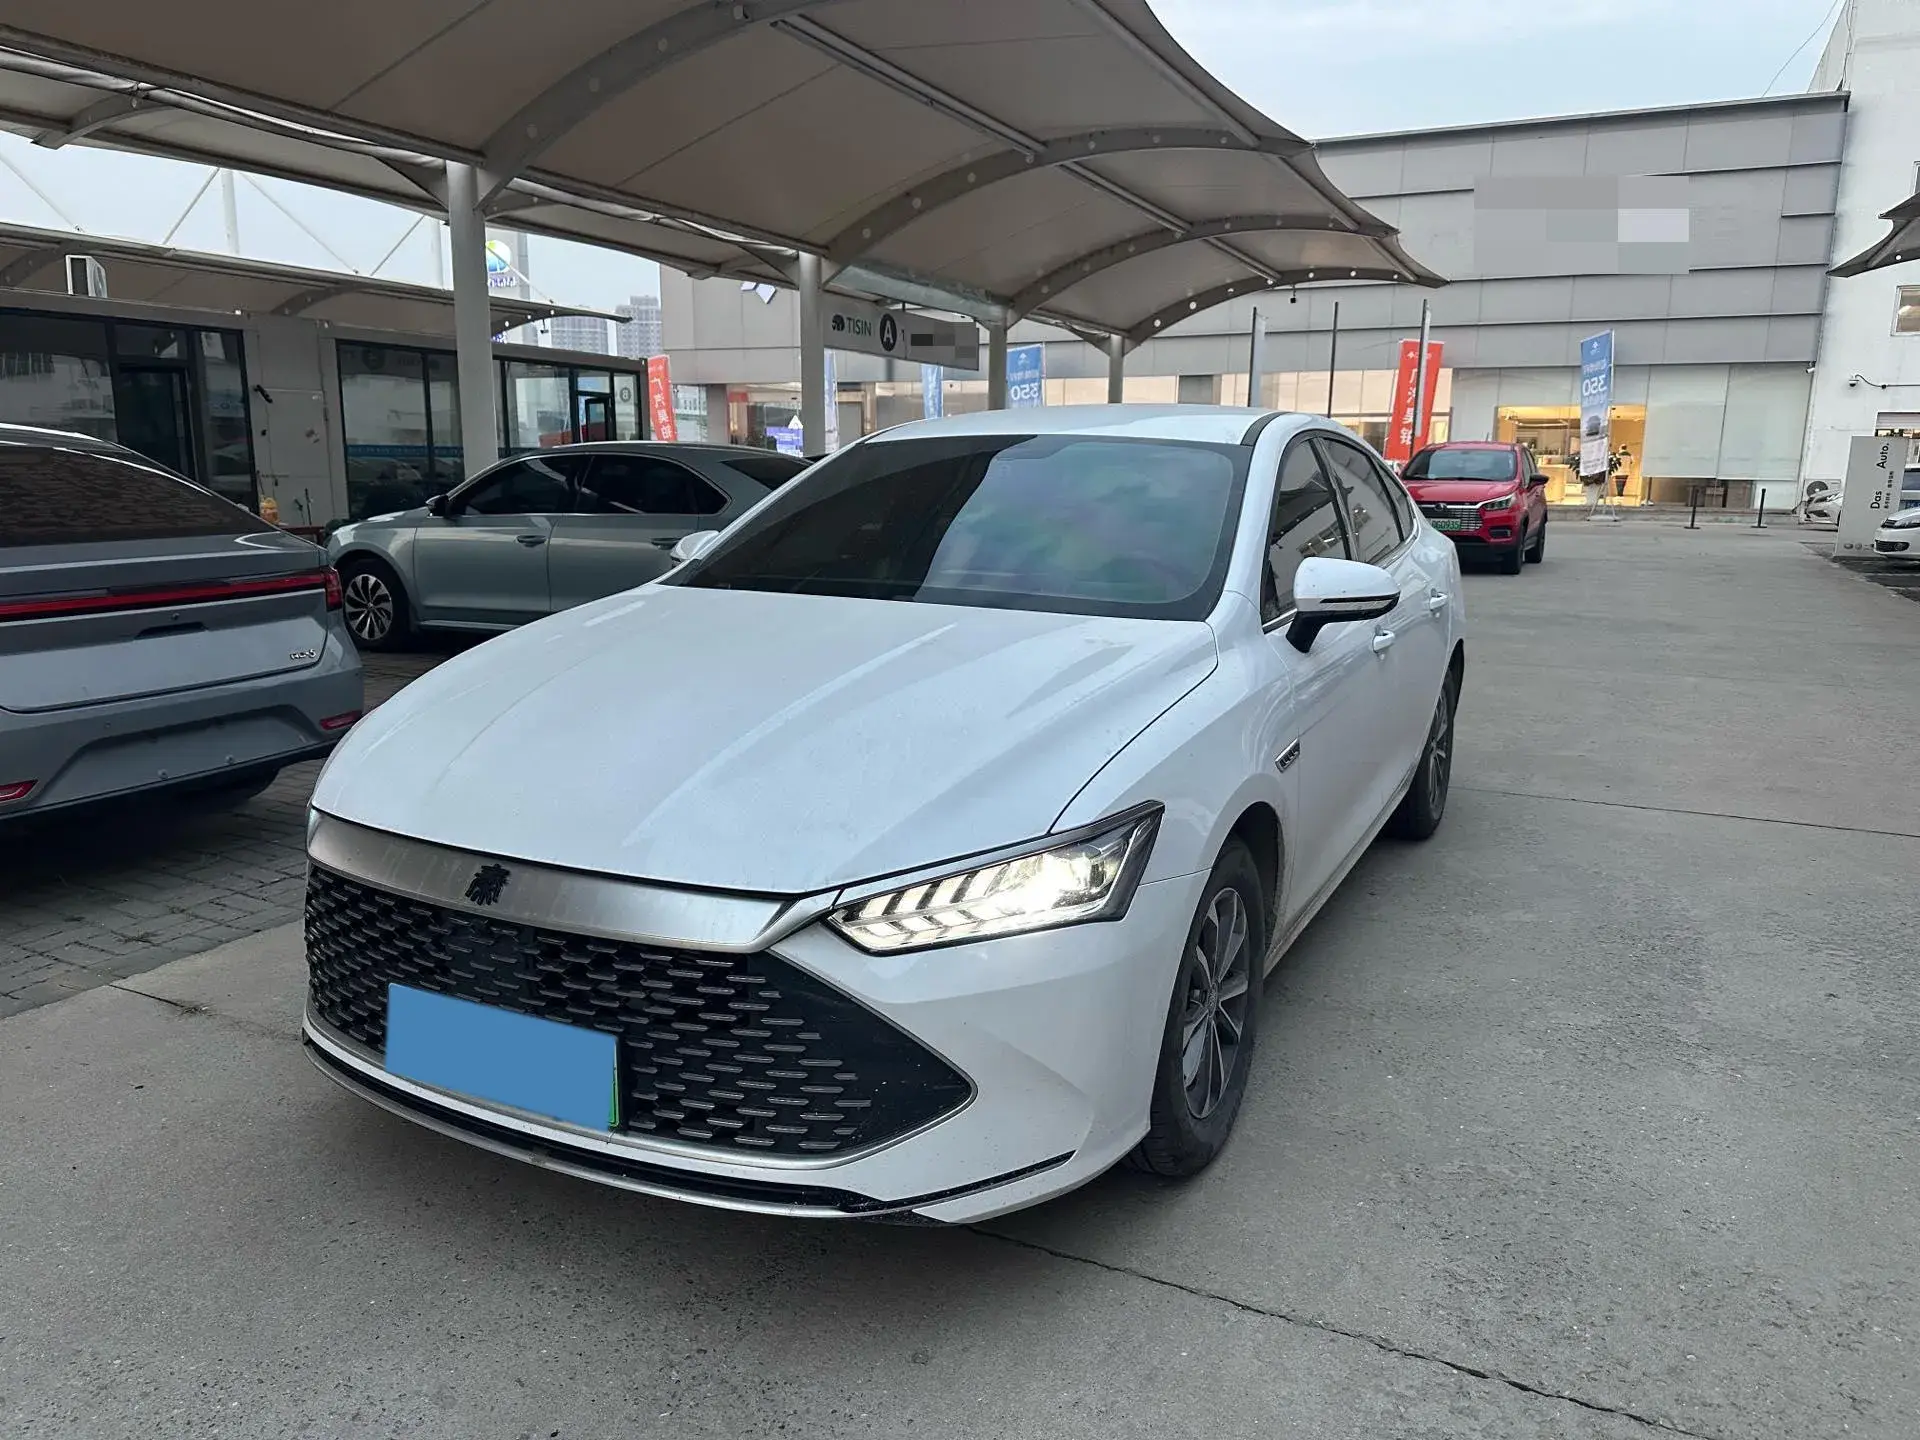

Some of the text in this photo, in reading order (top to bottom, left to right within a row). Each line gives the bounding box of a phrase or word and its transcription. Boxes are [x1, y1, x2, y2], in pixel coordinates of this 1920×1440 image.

[846, 316, 872, 337] TISIN
[883, 319, 894, 344] A
[1870, 490, 1882, 509] Das
